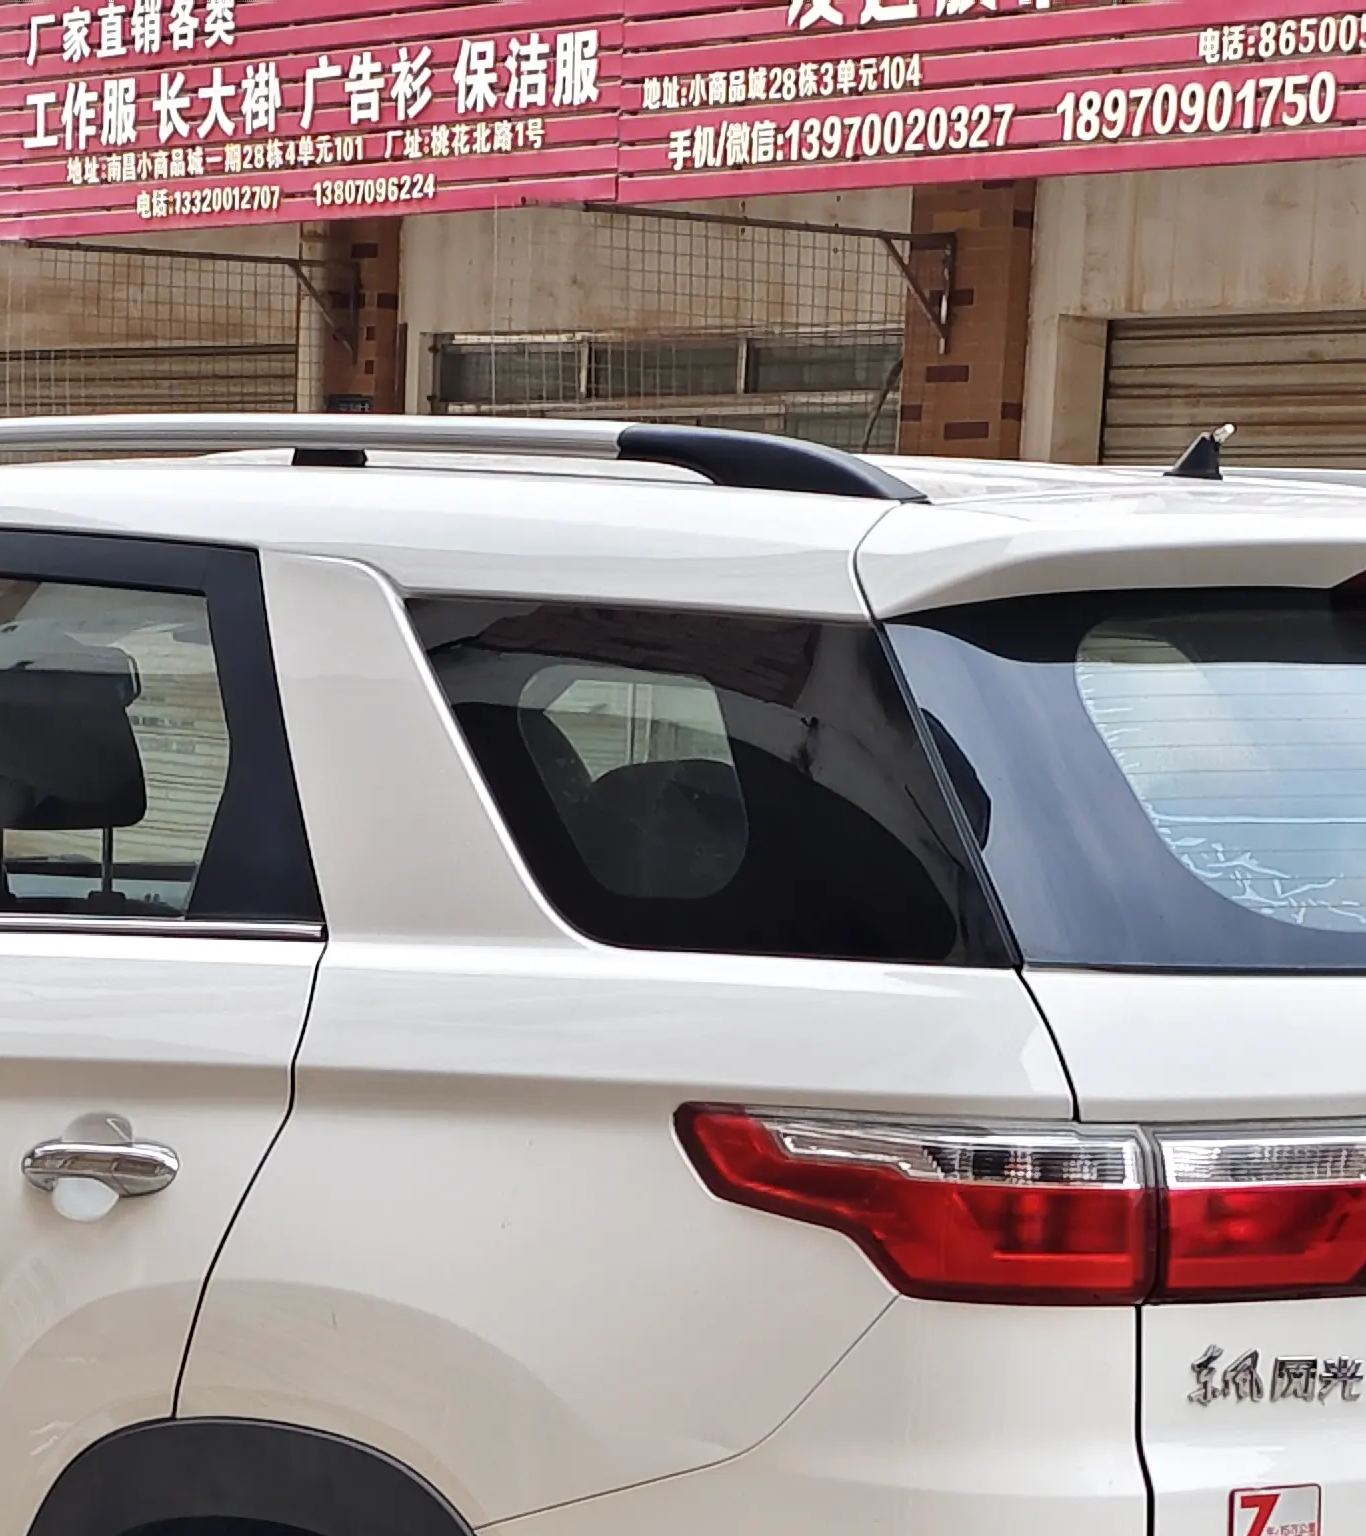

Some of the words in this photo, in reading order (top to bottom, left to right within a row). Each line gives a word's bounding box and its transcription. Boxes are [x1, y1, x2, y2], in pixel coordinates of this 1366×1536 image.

[26, 0, 235, 66] 厂家直销各类
[23, 78, 137, 150] 工作服
[152, 61, 282, 144] 长大褂
[300, 45, 433, 129] 广告衫
[453, 29, 599, 114] 保洁服
[668, 103, 1015, 171] 手机/微信:13970020327
[1056, 71, 1336, 141] 18970901750
[136, 184, 281, 219] 电话:13320012707
[313, 173, 436, 207] 13807096224
